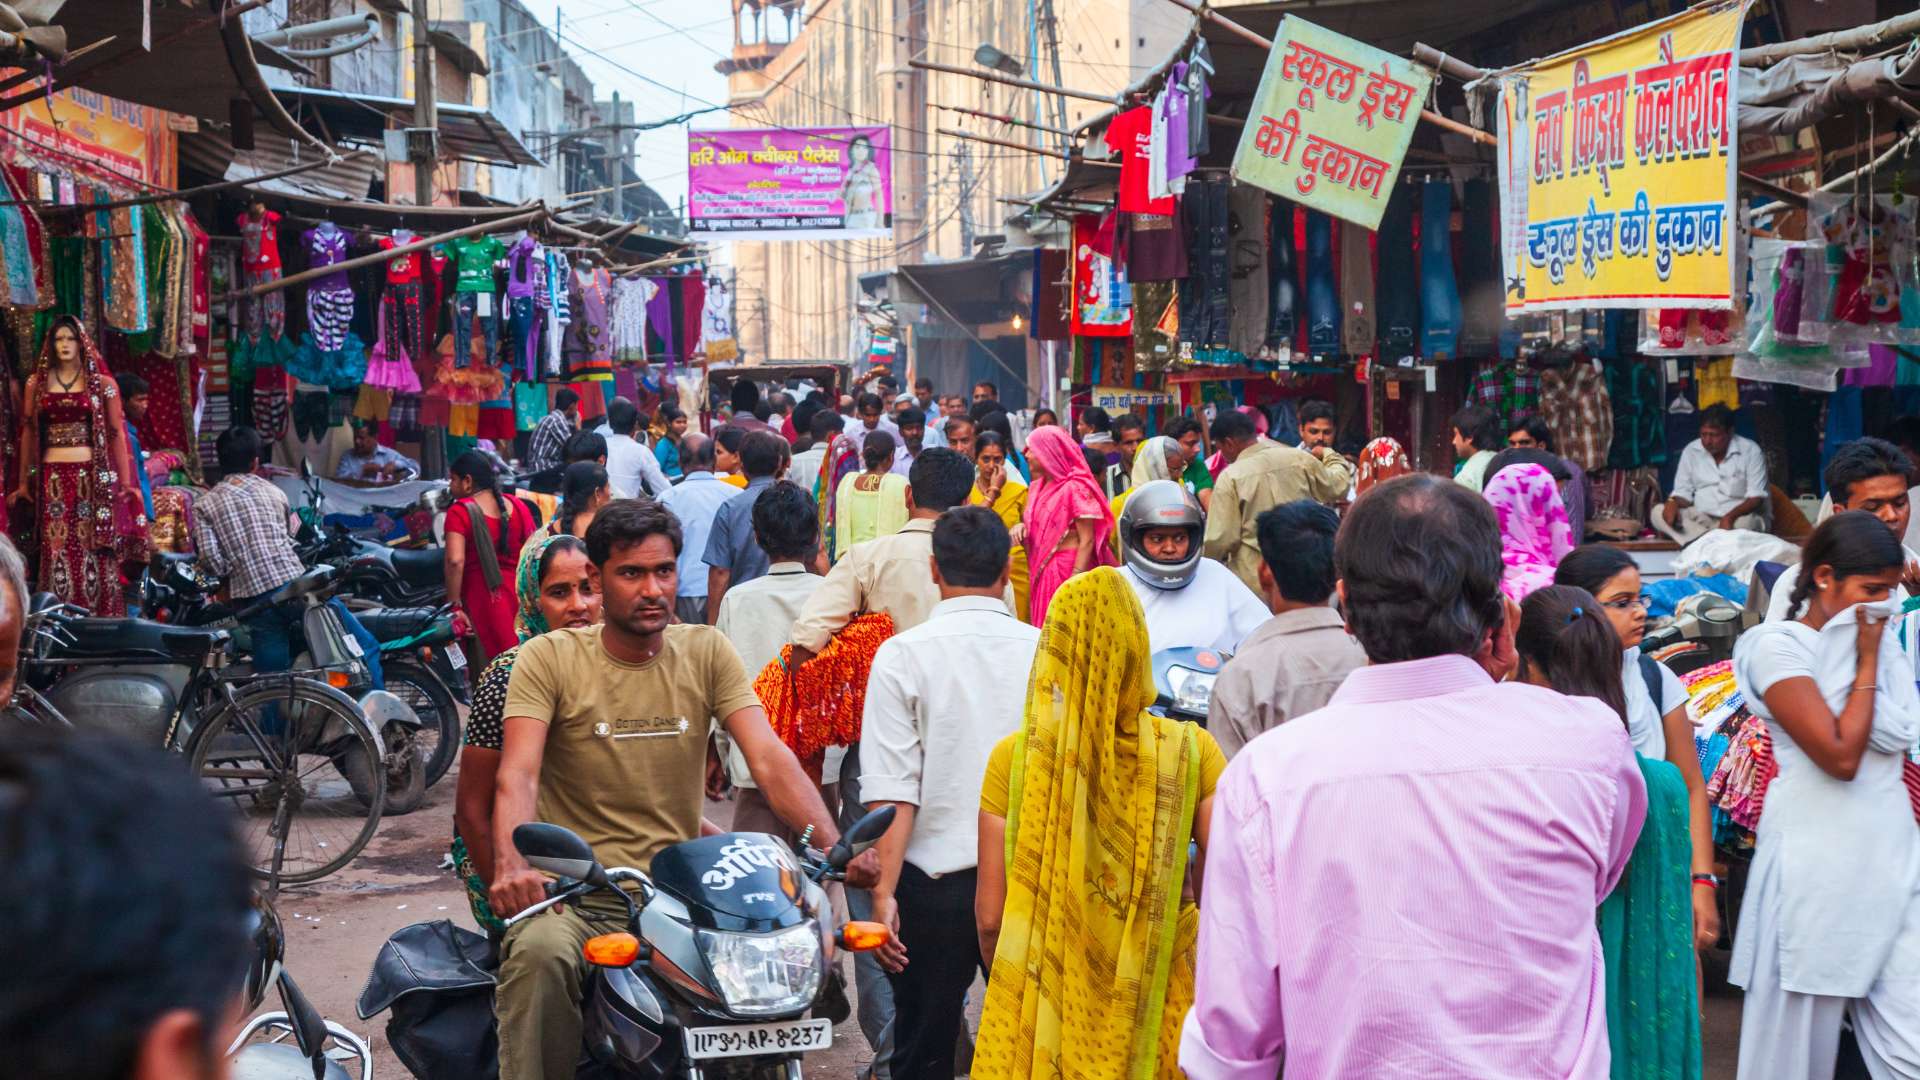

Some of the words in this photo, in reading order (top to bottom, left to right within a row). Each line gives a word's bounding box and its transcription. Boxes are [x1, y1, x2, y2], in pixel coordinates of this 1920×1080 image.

[1282, 39, 1364, 112] स्कूल
[1358, 61, 1417, 130] ड्रेस
[690, 147, 713, 167] हरि
[717, 149, 747, 165] ओम
[1255, 108, 1301, 164] की
[1296, 134, 1392, 199] दुकान
[1527, 216, 1579, 284] स्कूल
[1582, 195, 1616, 280] ड्रेस
[1619, 189, 1651, 258] की
[1655, 202, 1728, 281] दुकान
[742, 892, 776, 904] TVS
